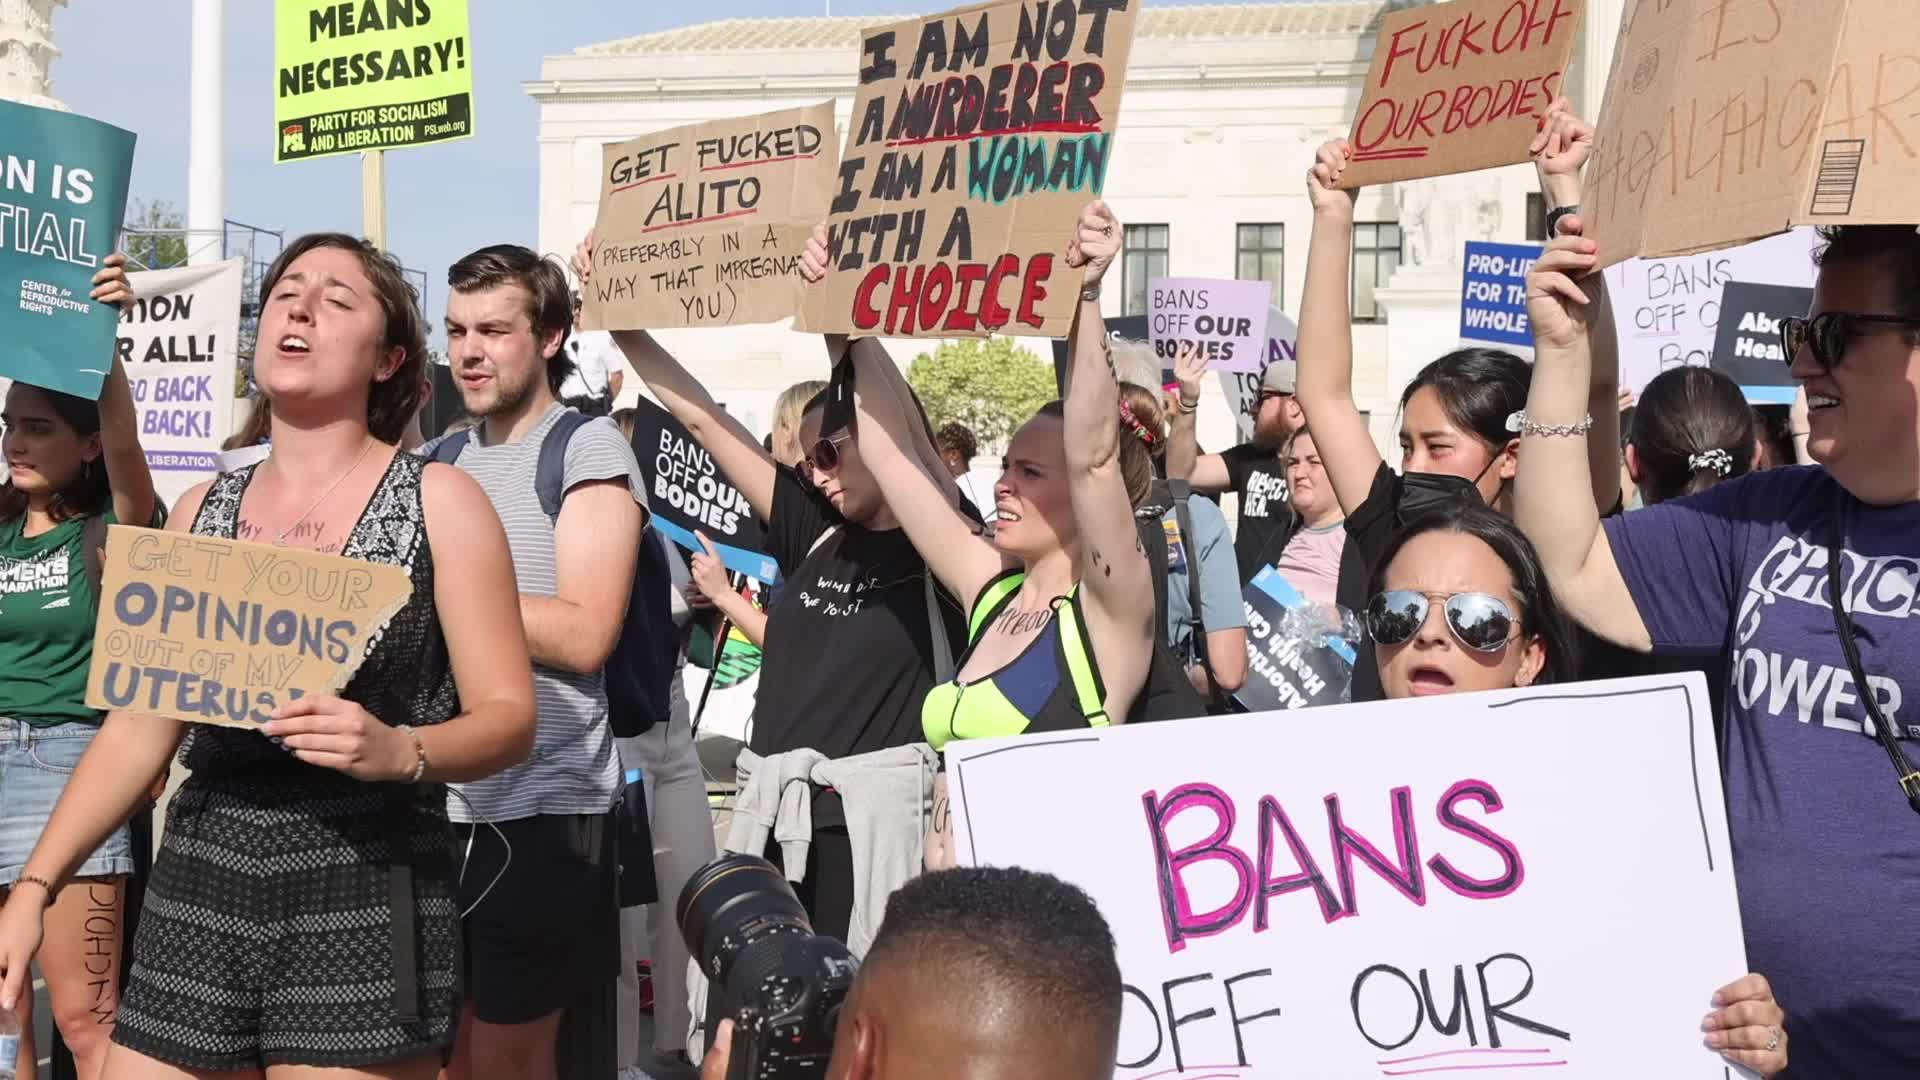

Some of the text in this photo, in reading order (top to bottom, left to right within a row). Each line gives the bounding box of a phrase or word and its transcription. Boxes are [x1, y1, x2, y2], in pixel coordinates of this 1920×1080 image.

[310, 0, 431, 42] MEANS
[860, 0, 1128, 84] I AM NOT
[280, 37, 465, 98] NECESSARY!
[1380, 12, 1486, 88] FUCK
[310, 99, 448, 132] PARTY FOR SOCIALISM
[855, 61, 1105, 147] A MURDERER
[1355, 90, 1446, 151] OUR
[1443, 71, 1561, 134] BODIES
[283, 131, 306, 153] PSL
[310, 125, 414, 152] AND LIBERATION
[424, 120, 465, 136] PSLweb.org
[0, 155, 94, 204] N IS
[610, 143, 680, 185] GET
[830, 133, 1111, 216] I AM A WOMAN
[643, 176, 761, 227] ALITO
[722, 231, 740, 253] IN
[762, 223, 778, 249] A
[827, 206, 972, 271] WITH A
[21, 280, 57, 296] CENTER
[595, 275, 637, 303] WAY
[650, 265, 704, 292] THAT
[851, 253, 1055, 336] CHOICE
[1154, 289, 1208, 310] BANS
[1465, 280, 1502, 303] FOR
[1648, 258, 1733, 300] BANS
[20, 289, 90, 314] REPRODUCTIVE
[20, 299, 53, 316] RIGHTS
[1465, 308, 1528, 333] WHOLE
[1635, 302, 1686, 331] OFF
[1154, 313, 1251, 337] OFF OUR
[144, 335, 216, 362] ALL!
[154, 375, 213, 402] BACK
[143, 410, 212, 438] BACK!
[656, 453, 697, 488] OFF
[660, 428, 715, 476] BANS
[655, 474, 740, 535] BODIES
[128, 534, 232, 582] GET
[242, 551, 374, 611] YOUR
[114, 582, 356, 664] OPINIONS
[105, 629, 303, 690] OUT OF MY
[1731, 648, 1902, 738] OWER
[1142, 778, 1525, 954] BANS
[1350, 952, 1571, 1051] OUR
